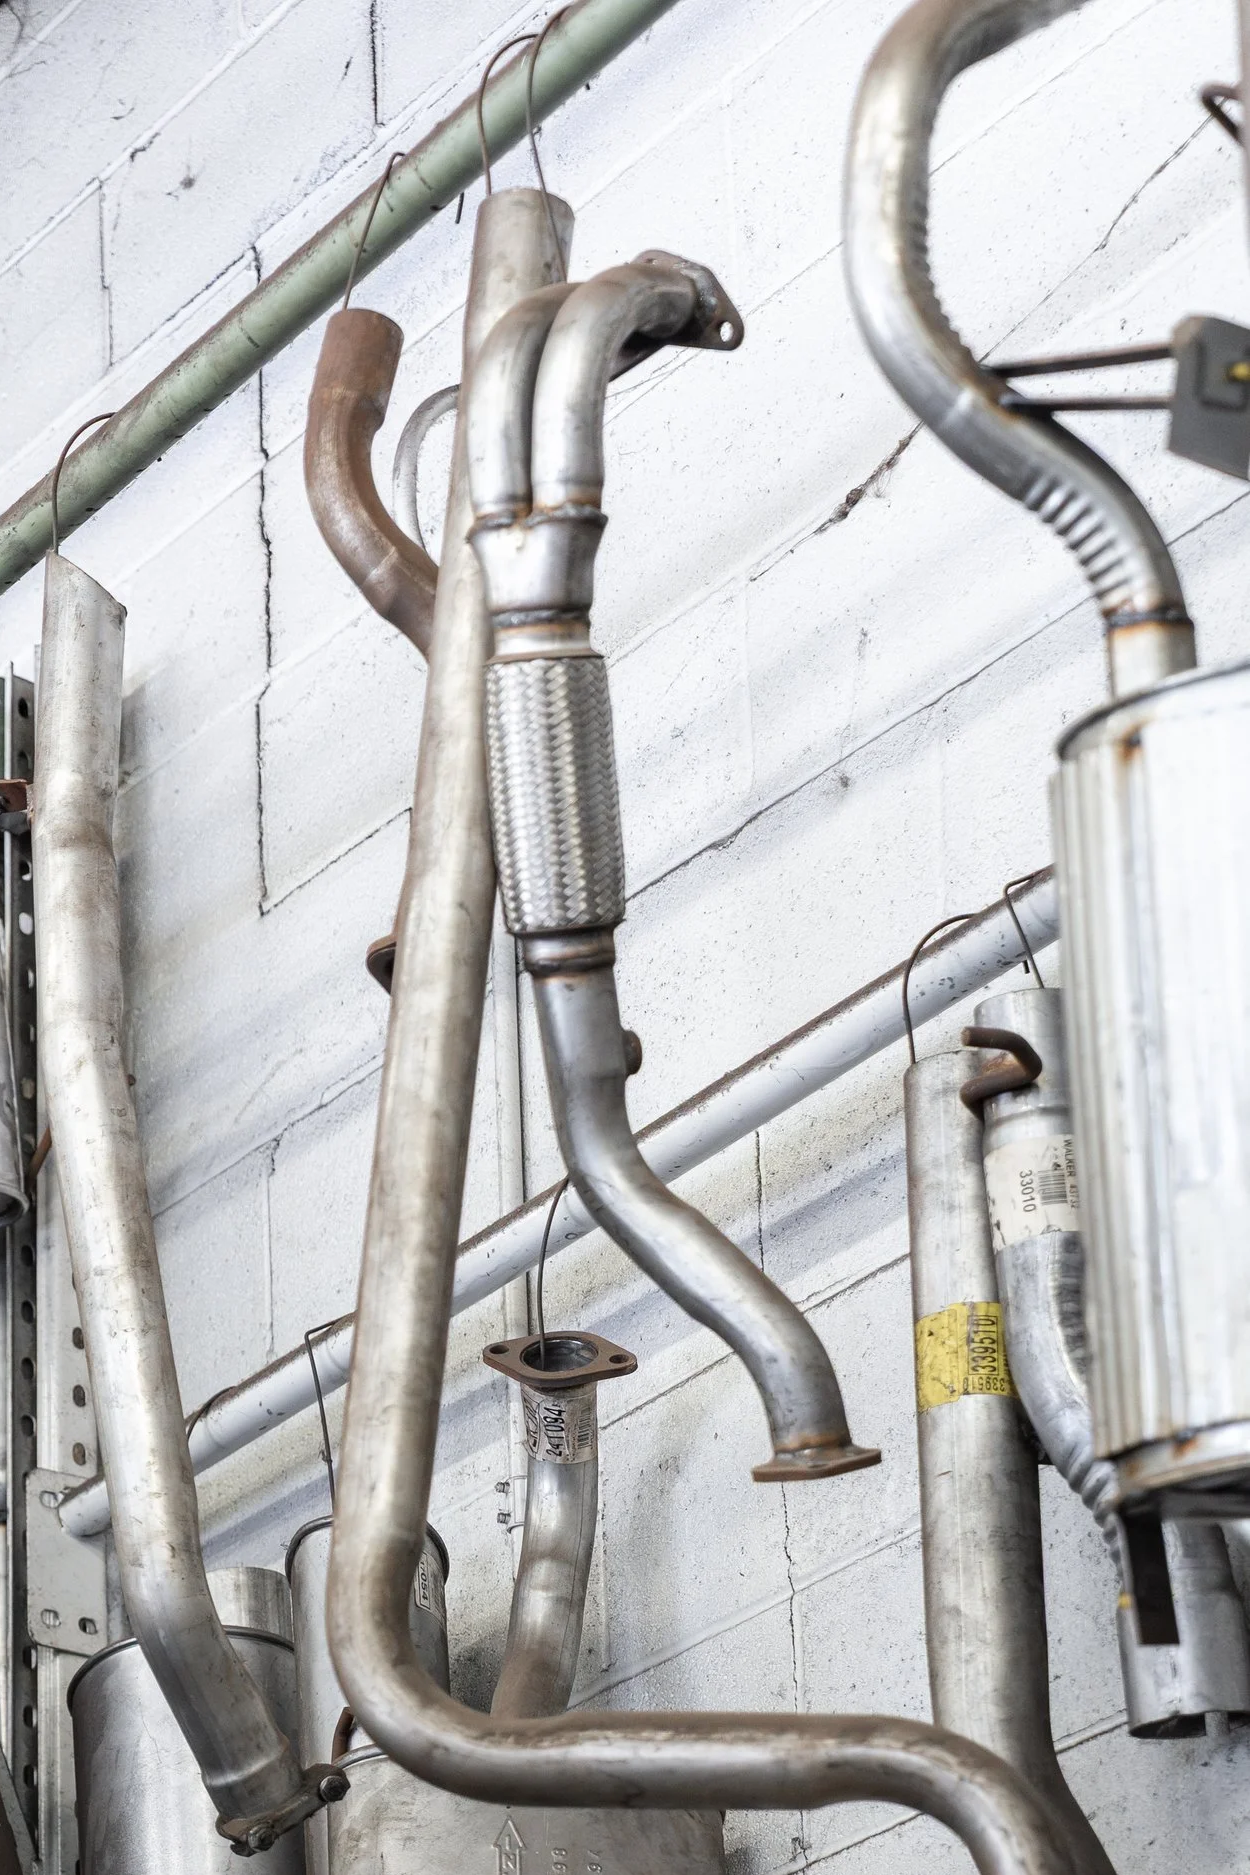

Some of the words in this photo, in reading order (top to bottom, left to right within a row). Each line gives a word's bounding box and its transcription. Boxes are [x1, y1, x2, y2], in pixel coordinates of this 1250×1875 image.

[1064, 1139, 1076, 1178] WALKER
[1019, 1170, 1037, 1212] 33010
[970, 1317, 997, 1373] 339510
